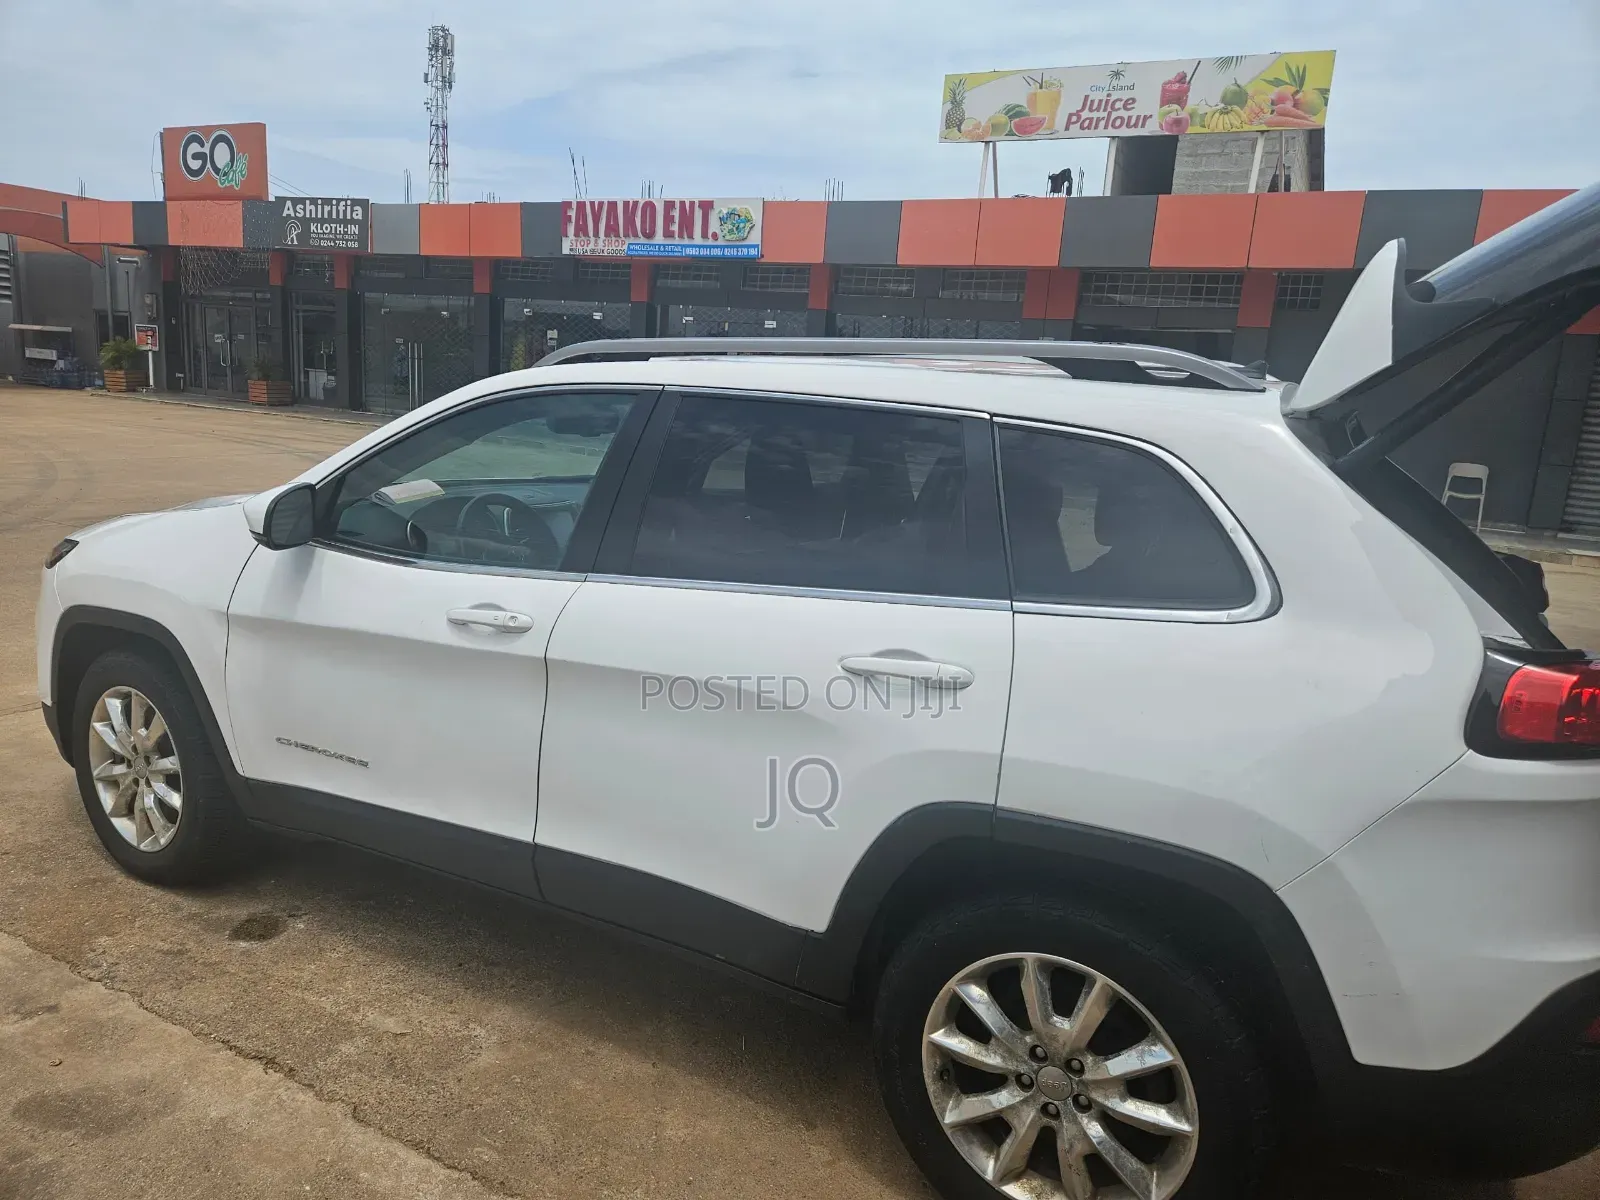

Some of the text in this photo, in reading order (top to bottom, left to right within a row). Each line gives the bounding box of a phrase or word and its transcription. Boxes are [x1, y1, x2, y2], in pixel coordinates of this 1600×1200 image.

[1089, 81, 1136, 93] City Island
[1075, 92, 1137, 114] Juice
[1063, 110, 1153, 132] Parlour
[181, 130, 236, 180] GO
[282, 199, 363, 220] Ashirifia
[310, 222, 359, 235] KLOTH-IN
[561, 200, 719, 241] FAYAKO ENT.
[320, 239, 335, 247] 0244
[569, 239, 591, 248] STOP
[602, 239, 626, 249] SHOP
[606, 248, 626, 256] GOODS
